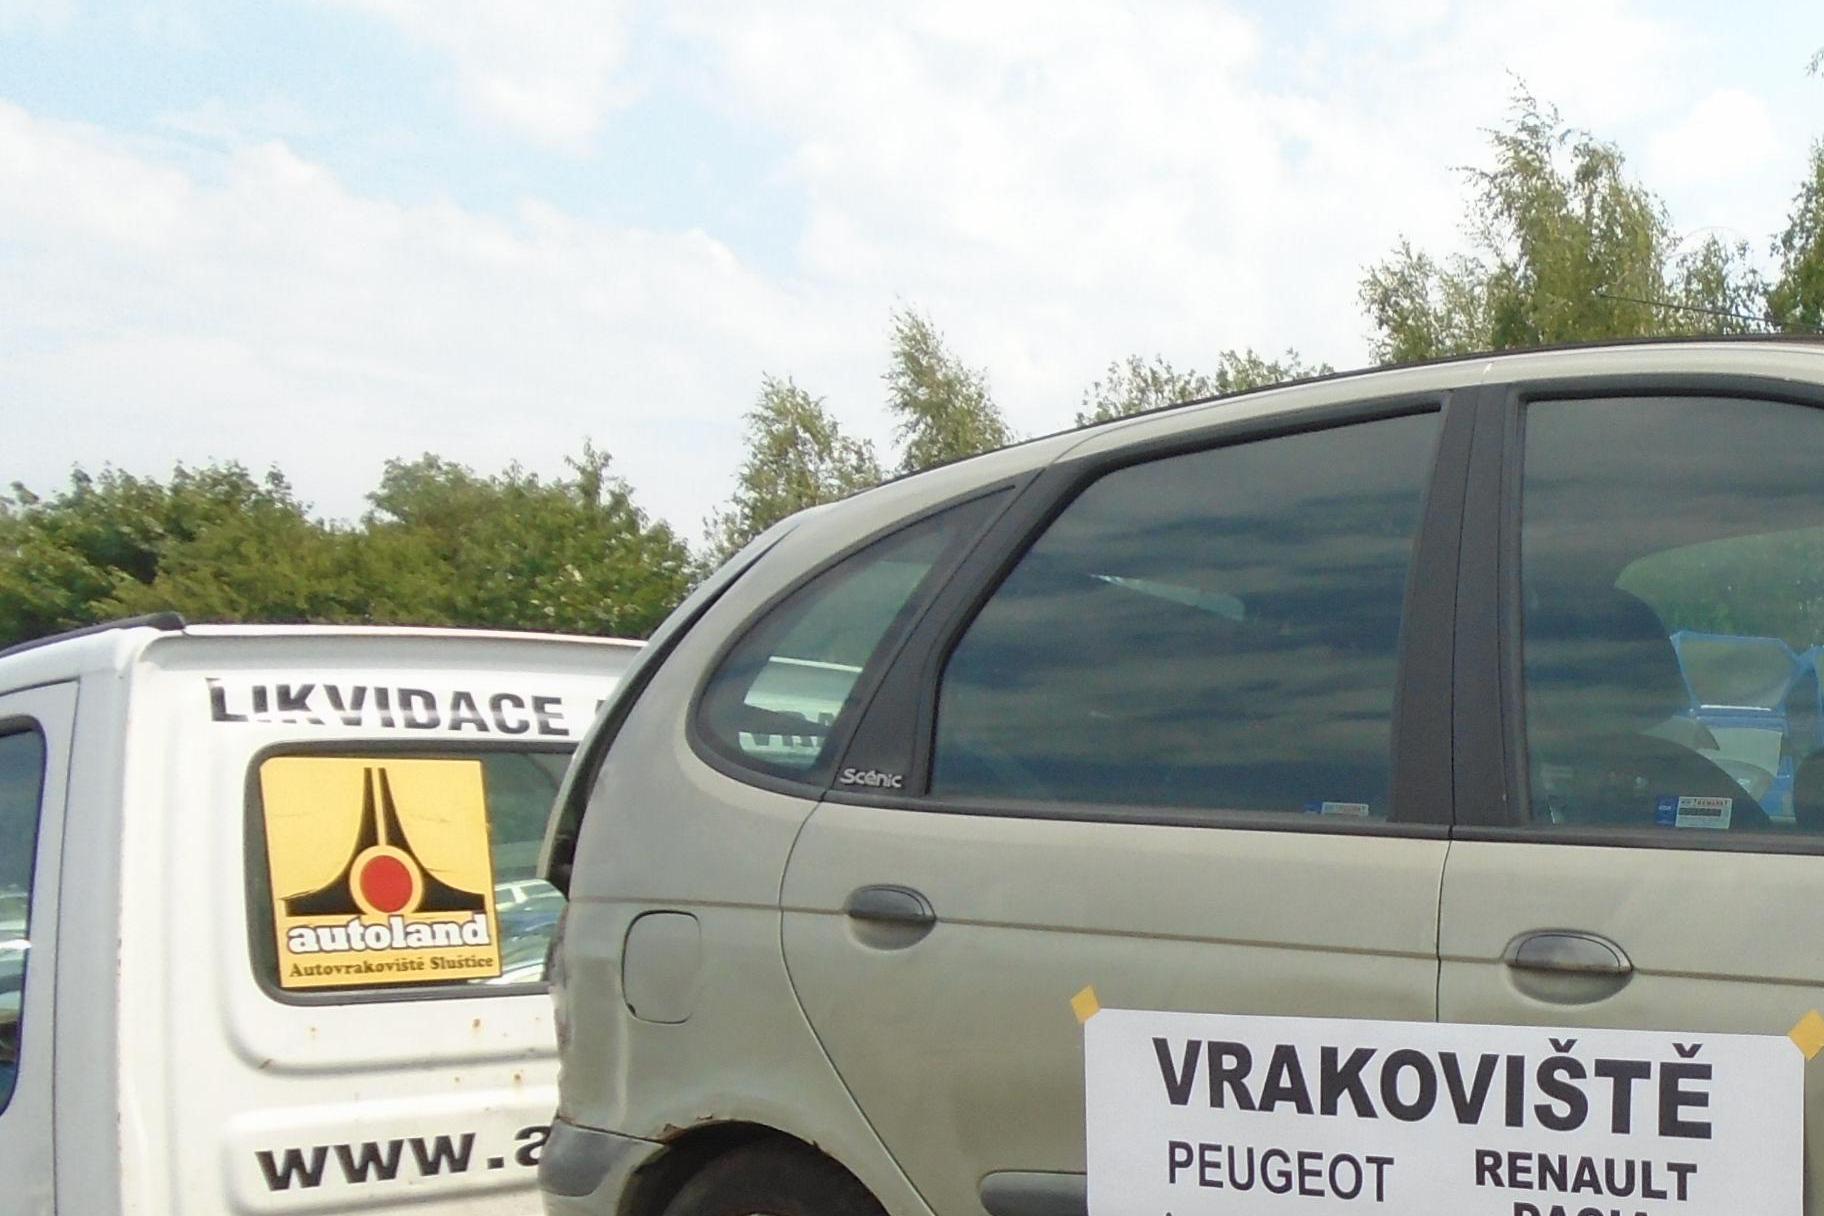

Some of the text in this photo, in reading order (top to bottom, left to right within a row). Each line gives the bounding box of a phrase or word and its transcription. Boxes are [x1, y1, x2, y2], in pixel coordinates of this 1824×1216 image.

[205, 677, 570, 736] LIKVIDACE
[840, 768, 902, 788] Scénic
[288, 914, 490, 955] autoland
[1152, 1038, 1712, 1139] VRAKOVIŠTĚ
[1168, 1140, 1394, 1202] PEUGEOT
[1475, 1148, 1697, 1201] RENAULT
